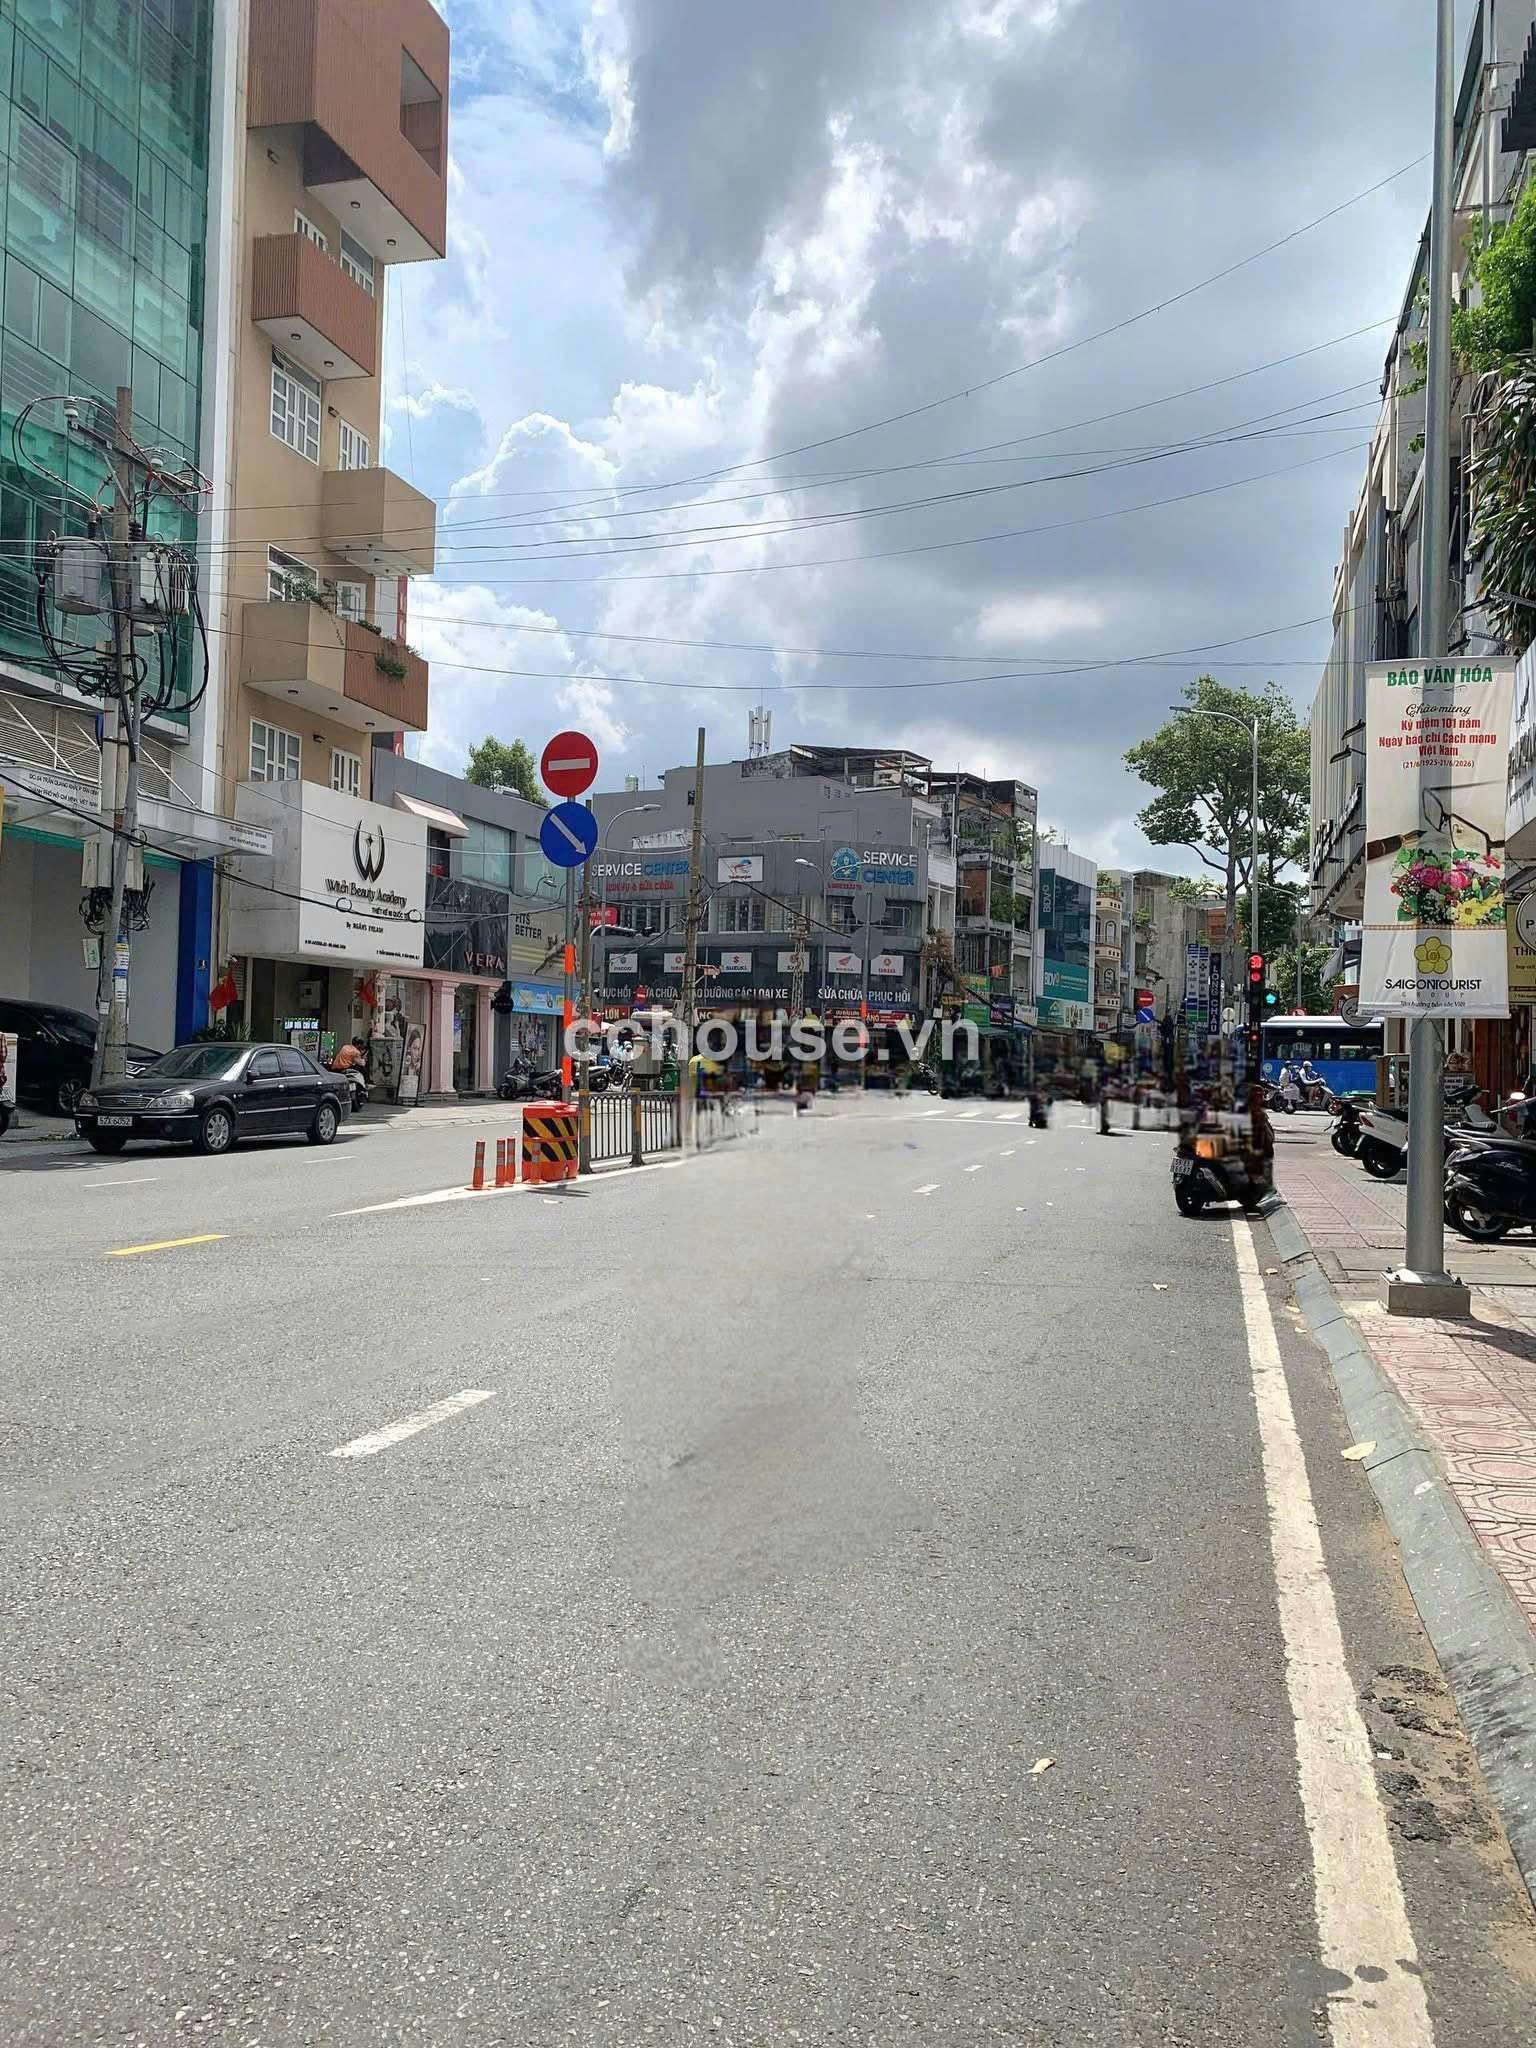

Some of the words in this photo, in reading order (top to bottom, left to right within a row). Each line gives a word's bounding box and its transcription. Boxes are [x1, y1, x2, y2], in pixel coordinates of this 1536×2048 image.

[1387, 667, 1419, 686] BÁO
[1423, 665, 1456, 684] VĂN
[1460, 664, 1493, 682] HÓA
[1405, 703, 1438, 717] Chào
[1439, 746, 1459, 756] Nam
[863, 850, 918, 867] SERVICE
[591, 862, 642, 877] SERVICE
[863, 869, 915, 886] CENTER
[351, 882, 376, 902] Beauty
[377, 888, 408, 909] Academy
[515, 924, 542, 940] BETTER
[464, 951, 505, 970] VERA
[600, 986, 617, 1000] HỤC
[656, 985, 678, 999] CHỮA
[704, 985, 734, 999] DƯỠNG
[775, 988, 789, 999] XE
[1385, 978, 1482, 991] SAIGONTOURIST
[818, 986, 837, 999] SỬA
[838, 986, 863, 1000] CHỮA
[868, 991, 893, 1002] PHỤC
